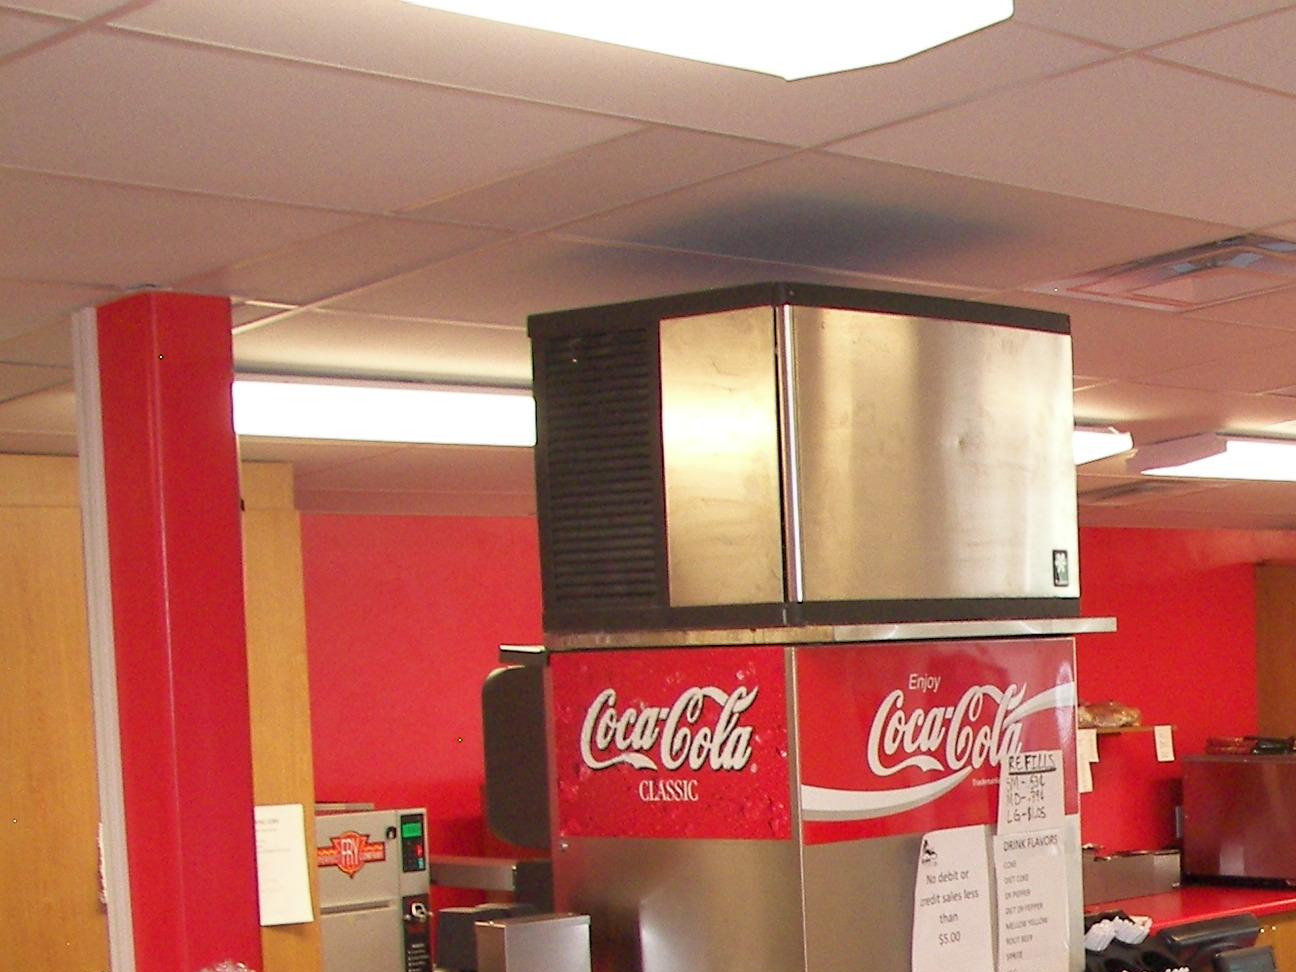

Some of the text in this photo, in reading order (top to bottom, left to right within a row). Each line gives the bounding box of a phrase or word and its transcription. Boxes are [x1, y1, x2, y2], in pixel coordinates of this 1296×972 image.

[909, 673, 942, 693] Enjoy
[580, 685, 759, 771] Coca-Cola
[867, 682, 1027, 776] Coca-Cola
[639, 779, 699, 802] CLASSIC
[926, 875, 936, 885] No
[938, 870, 958, 883] debit
[942, 891, 962, 904] sales
[964, 889, 980, 900] less
